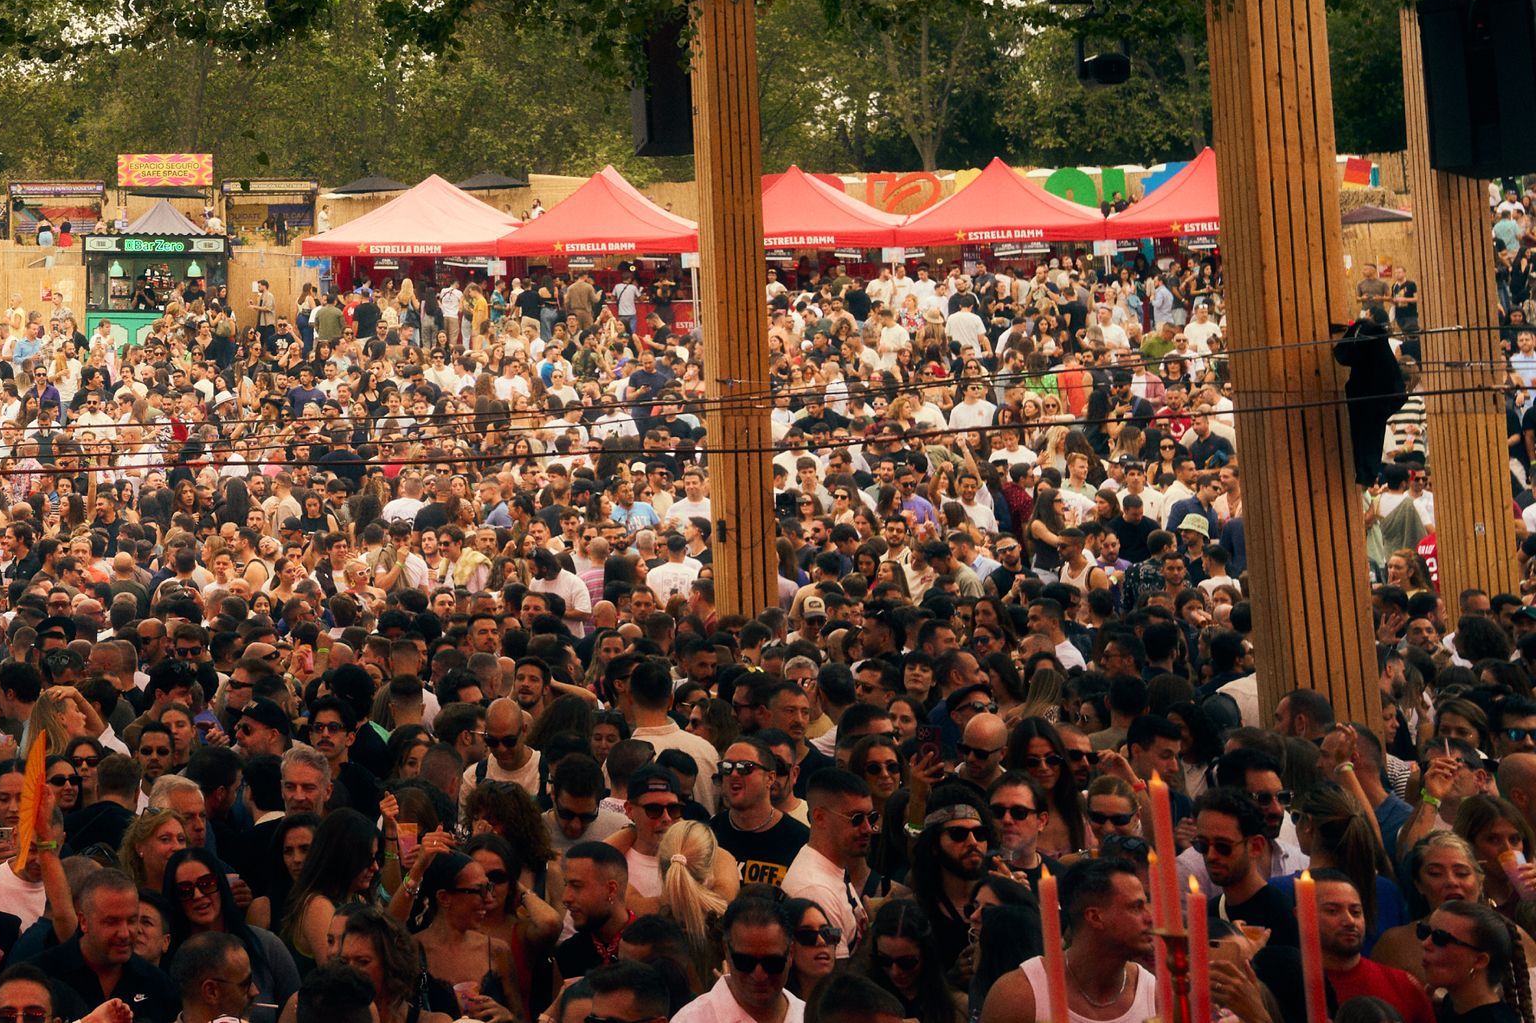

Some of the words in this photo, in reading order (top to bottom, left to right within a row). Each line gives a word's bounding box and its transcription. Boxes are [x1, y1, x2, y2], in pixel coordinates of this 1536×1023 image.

[129, 162, 164, 170] ESPACIO
[166, 162, 200, 170] SEGURO
[968, 231, 1013, 240] ESTRELLA
[1014, 229, 1044, 239] DAMM
[135, 239, 155, 251] Bar
[154, 239, 185, 252] Zero
[763, 236, 805, 246] ESTRELLA
[806, 235, 835, 245] DAMM
[369, 245, 412, 254] ESTRELLA
[413, 245, 442, 254] DAMM
[565, 242, 607, 252] ESTRELLA
[608, 242, 636, 251] DAMM
